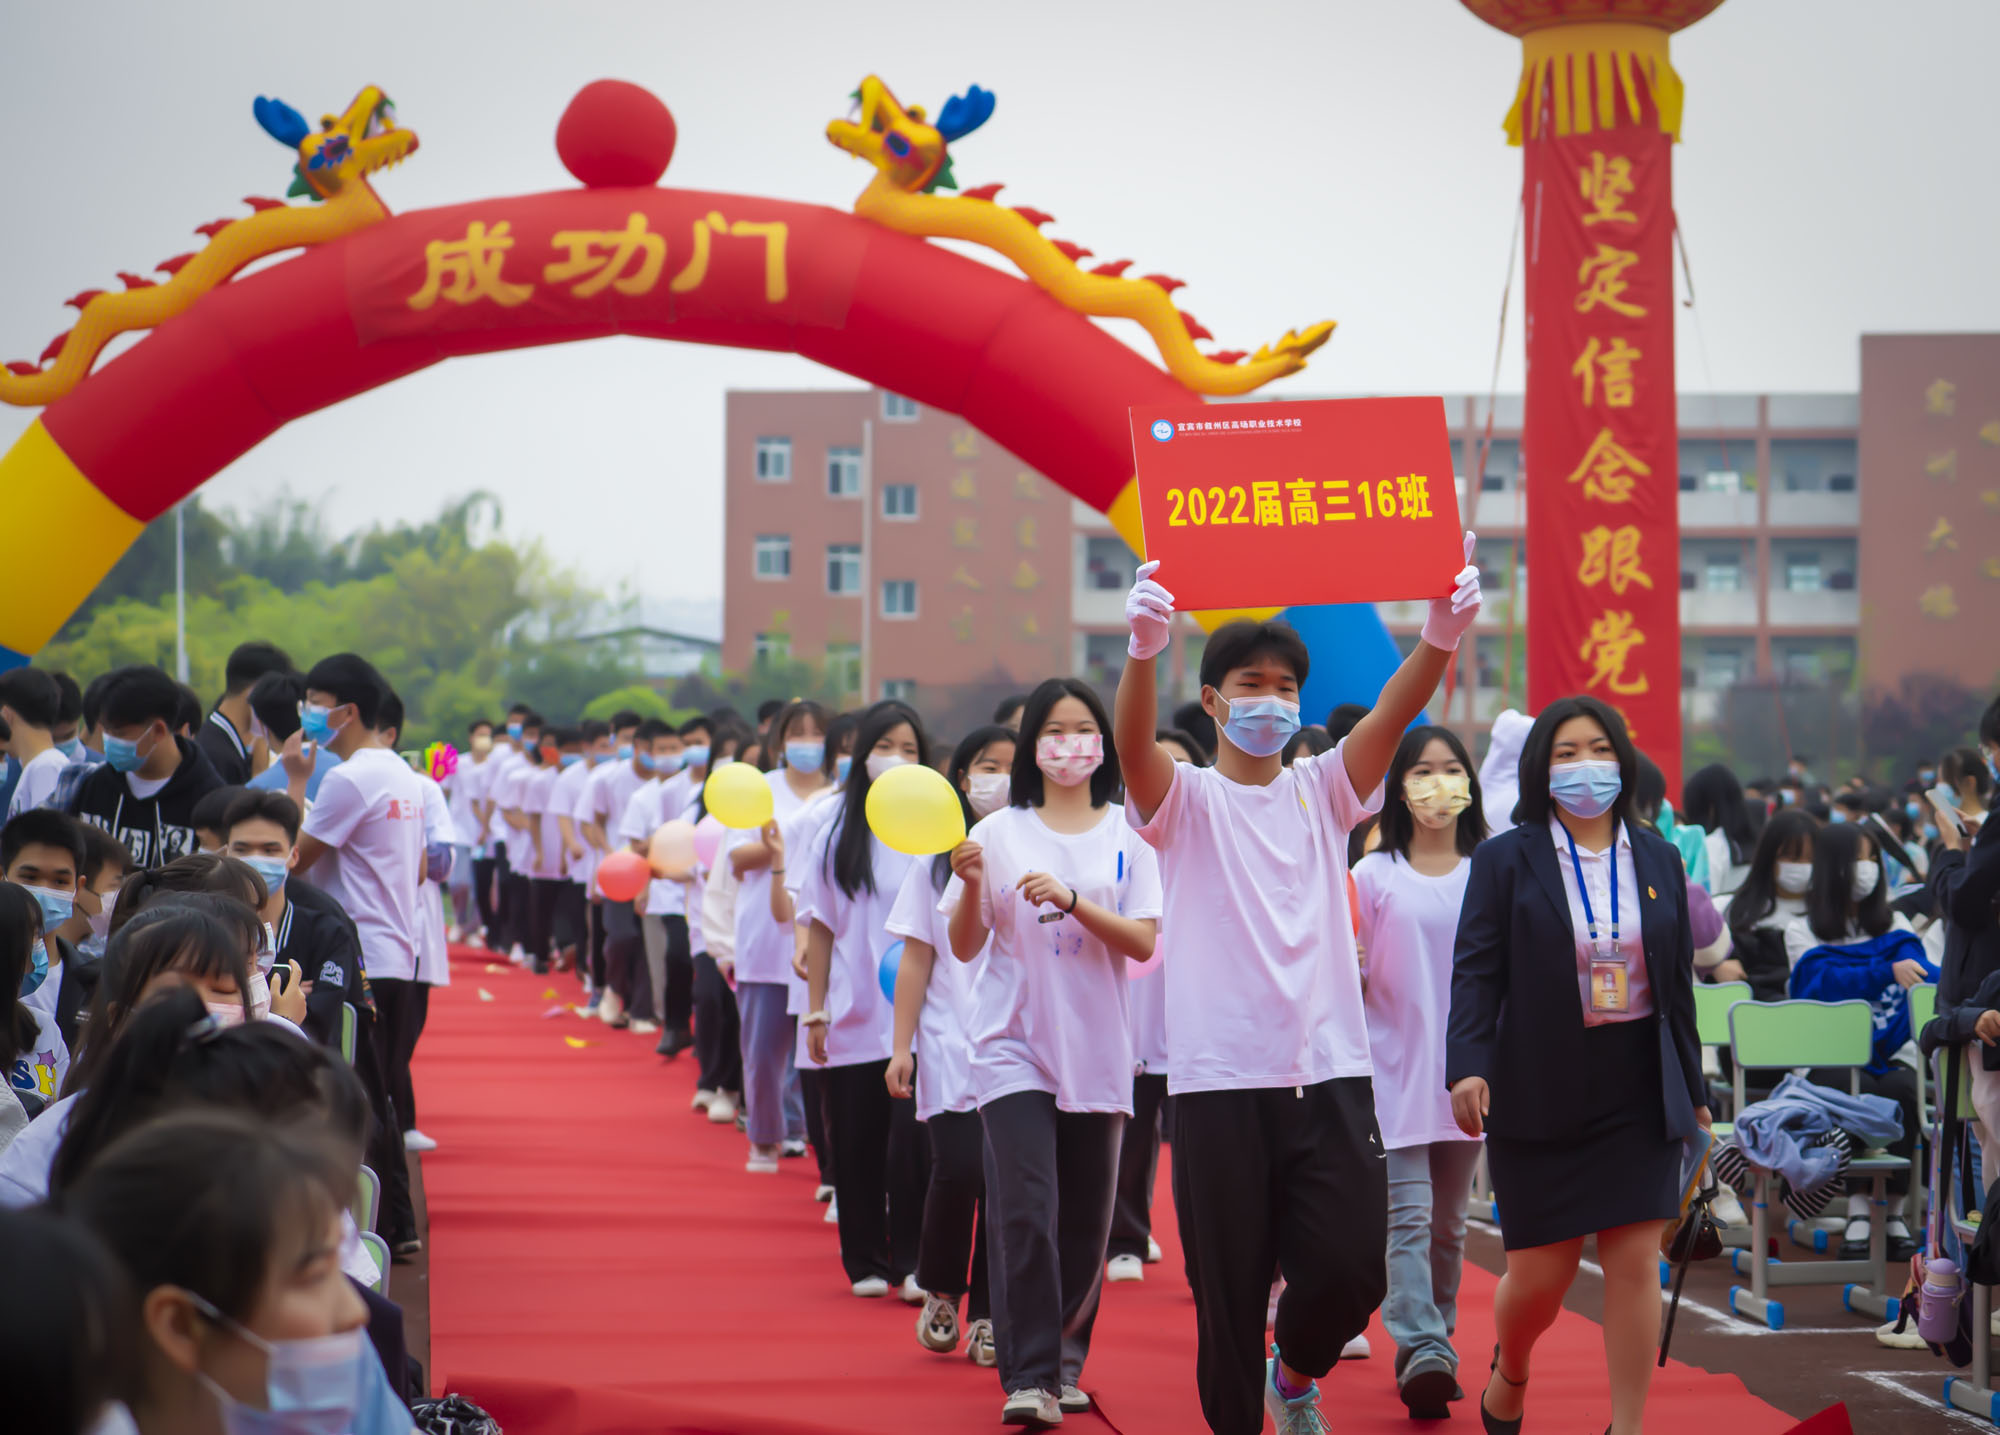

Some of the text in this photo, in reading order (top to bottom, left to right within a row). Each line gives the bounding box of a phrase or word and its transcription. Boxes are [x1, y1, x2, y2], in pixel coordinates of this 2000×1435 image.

[406, 211, 789, 310] 成功门
[1564, 149, 1655, 739] 坚定信念跟党
[1166, 473, 1433, 528] 2022届高三16班
